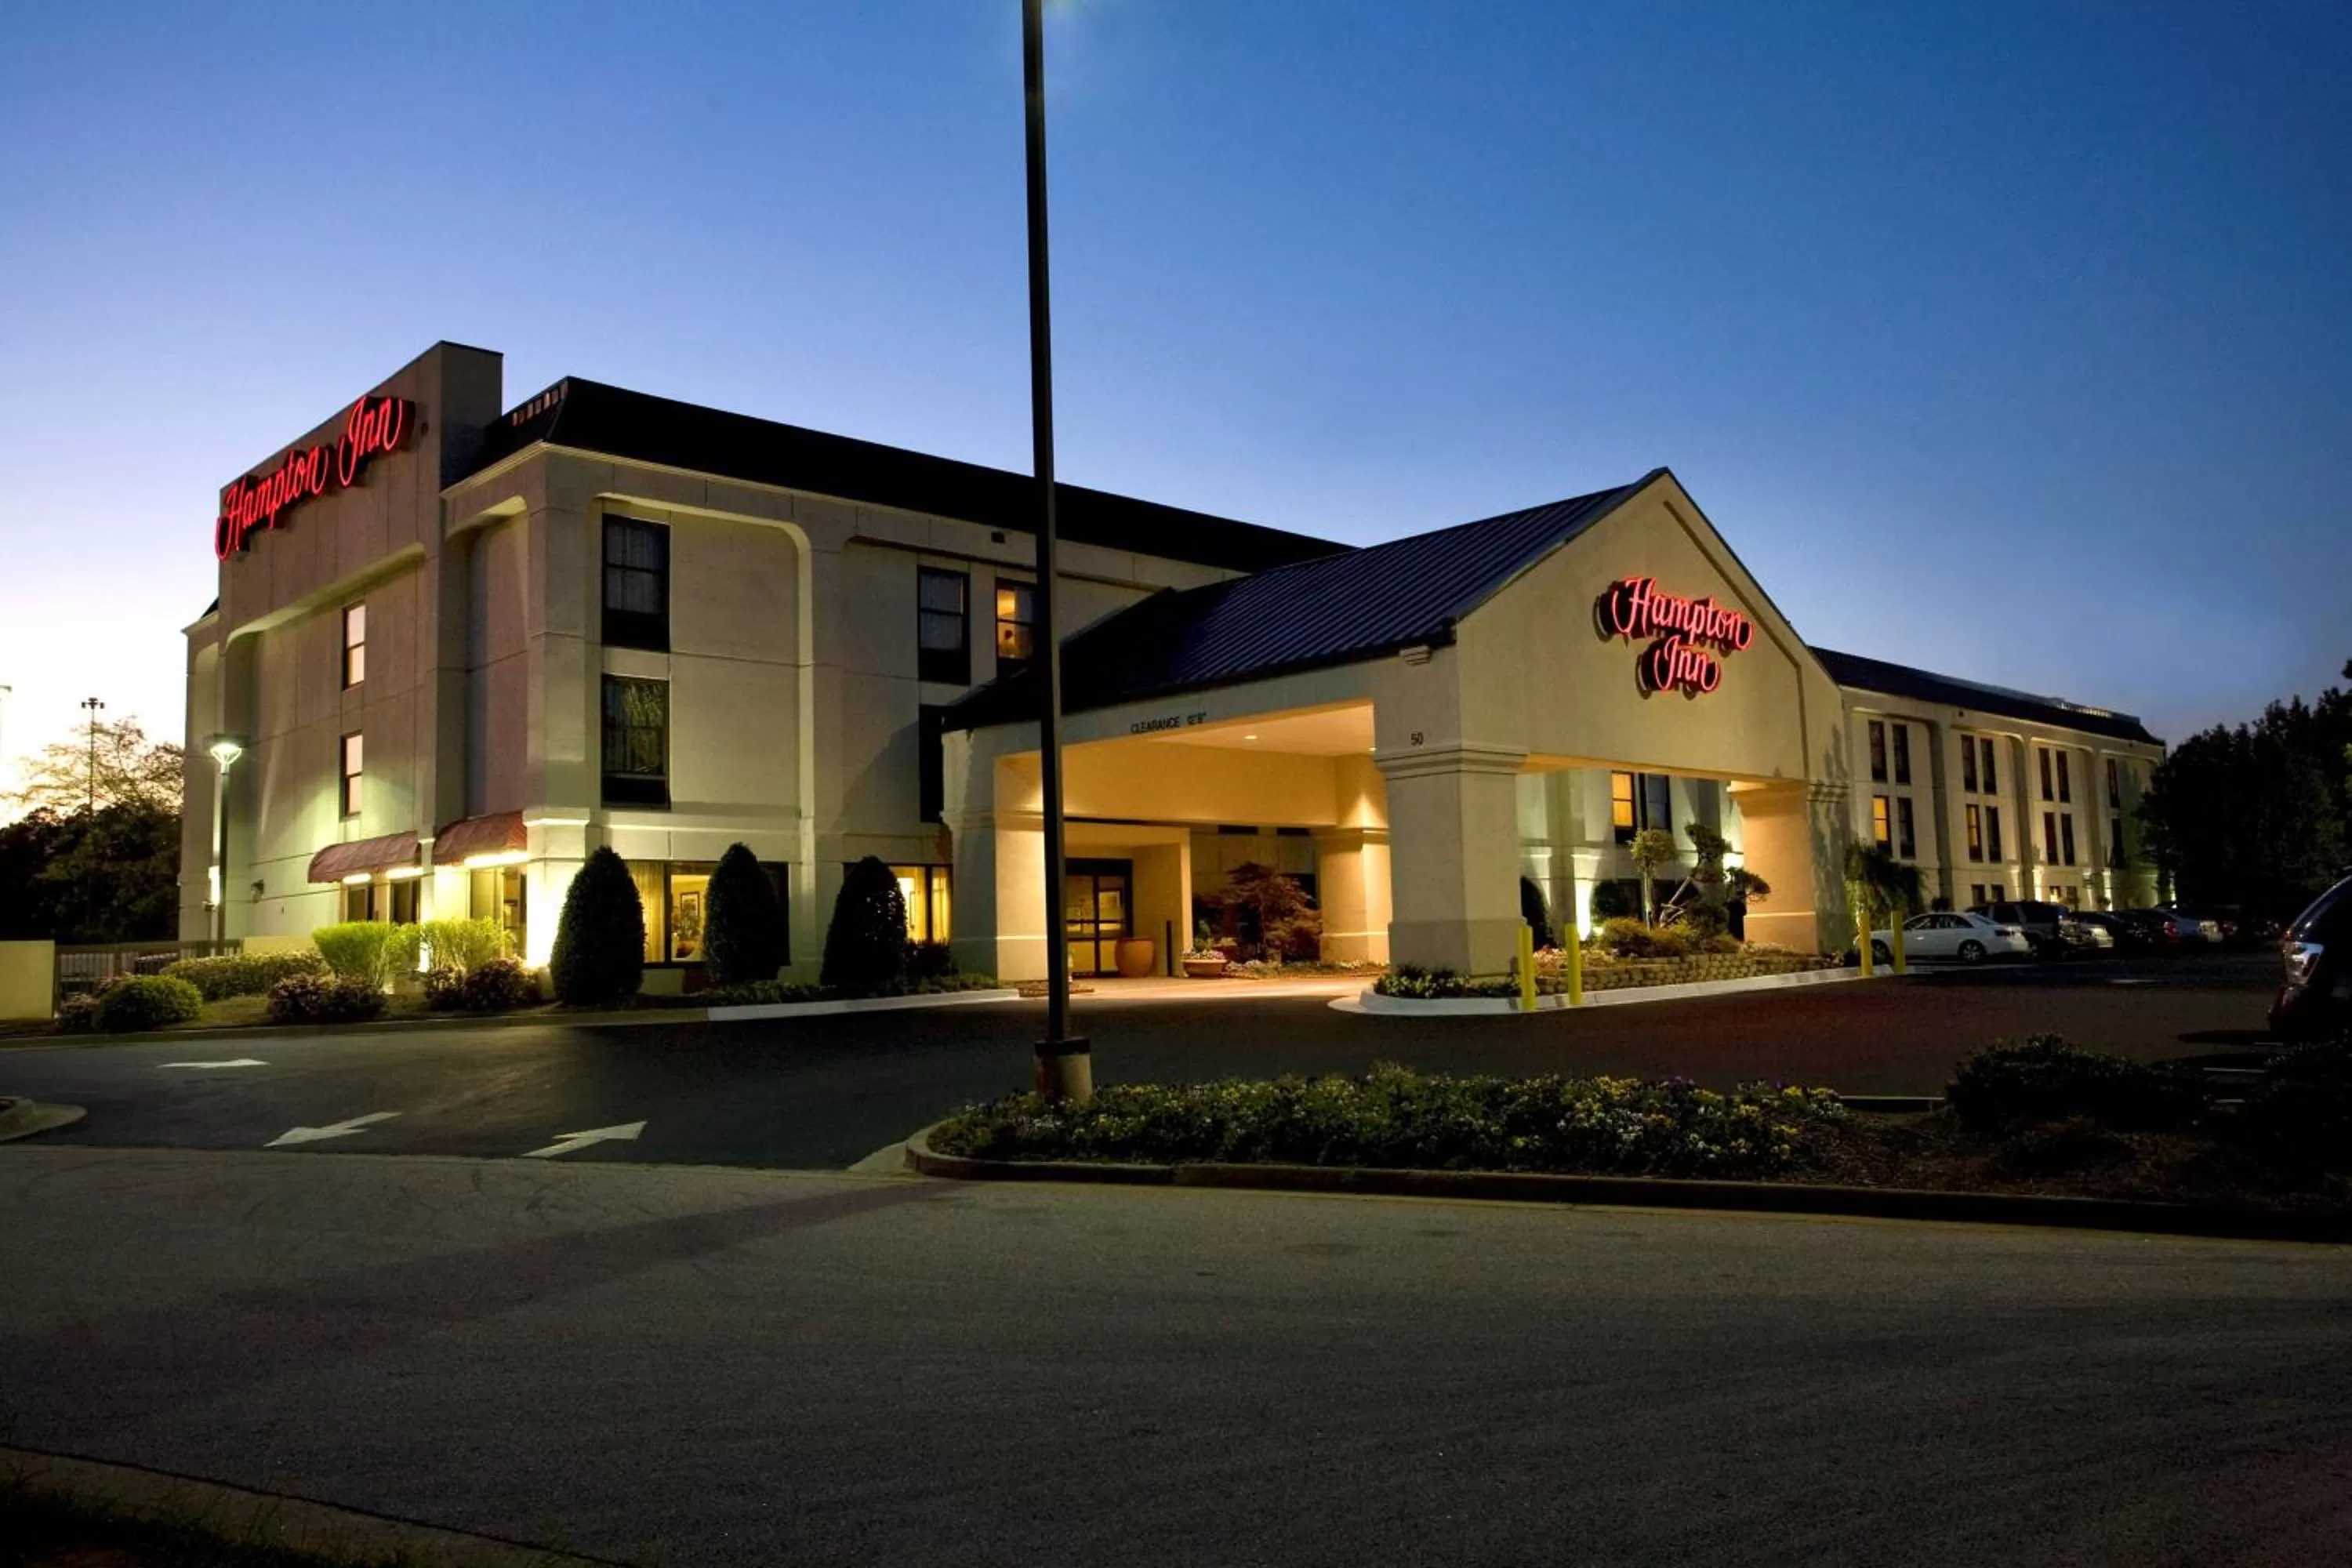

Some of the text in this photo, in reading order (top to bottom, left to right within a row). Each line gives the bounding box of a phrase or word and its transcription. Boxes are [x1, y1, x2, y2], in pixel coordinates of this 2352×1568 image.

[215, 395, 402, 561] Hampton Inn
[1611, 577, 1754, 651] Hampton
[1653, 634, 1721, 693] Inn
[1130, 716, 1181, 735] CLEARANCE
[1410, 731, 1425, 746] 50
